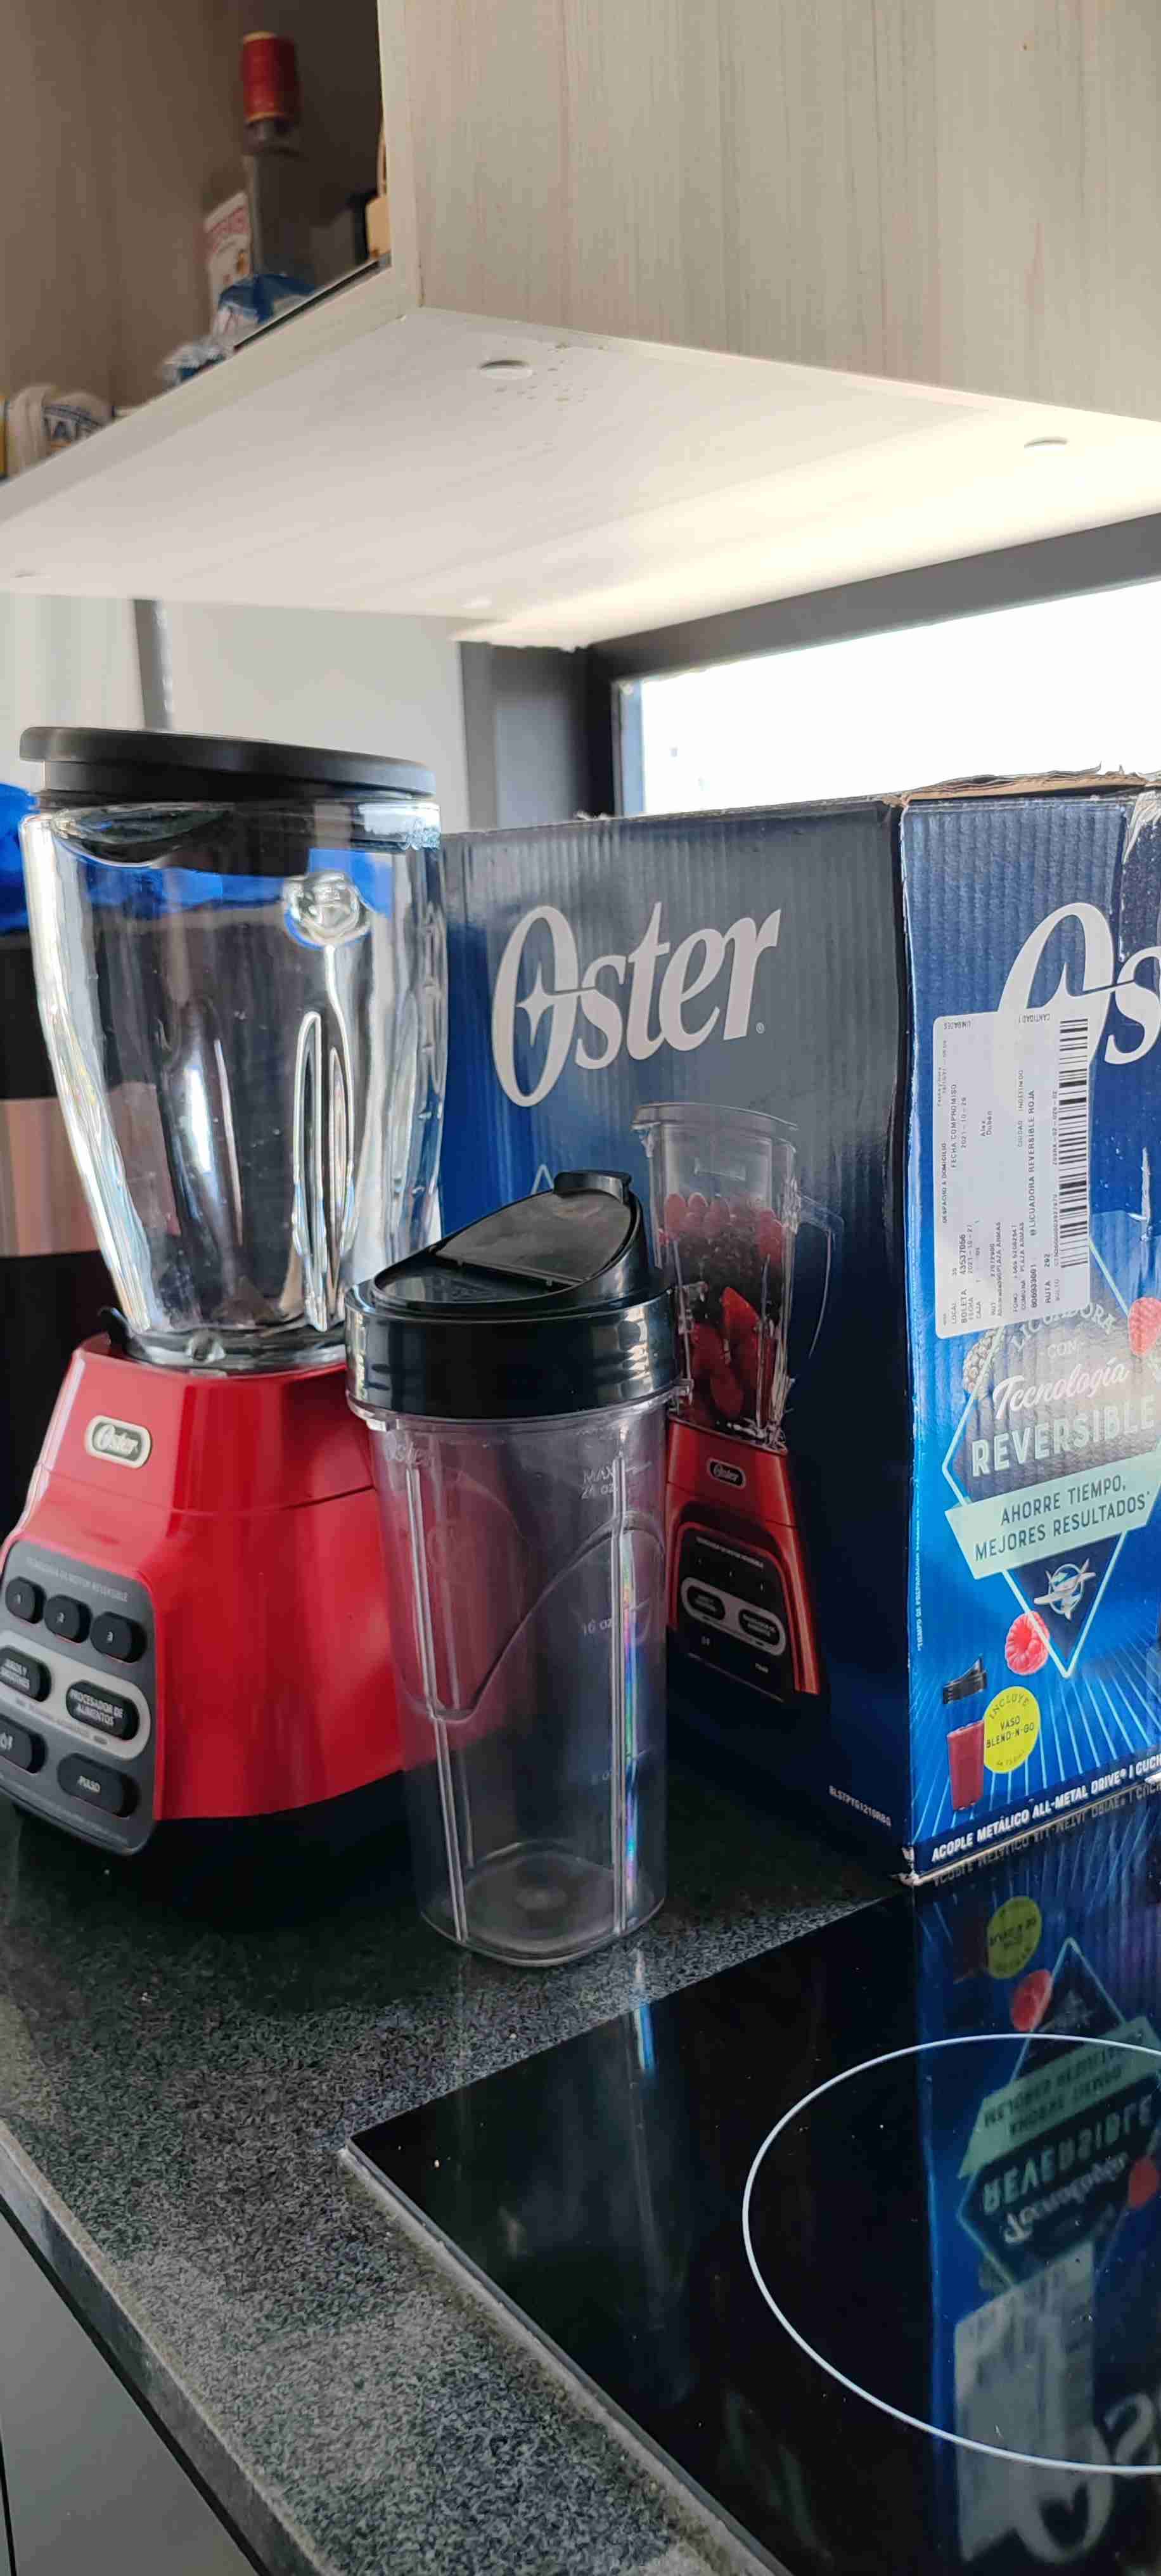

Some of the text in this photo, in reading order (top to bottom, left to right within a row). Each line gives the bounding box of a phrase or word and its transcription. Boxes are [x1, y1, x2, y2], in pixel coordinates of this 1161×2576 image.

[491, 902, 781, 1107] Oster
[1048, 1339, 1077, 1358] CON
[992, 1357, 1131, 1420] Tecnología
[972, 1393, 1156, 1478] REVERSIBLE
[1000, 1474, 1127, 1526] AHORRE TIEMPO,
[973, 1523, 1046, 1562] MEJORES
[56, 1611, 65, 1625] 2
[106, 1629, 115, 1643] 3
[113, 1706, 123, 1719] DE
[989, 1693, 1030, 1720] INCLUYE
[985, 1722, 1035, 1749] BLEND-N-GO
[1000, 1715, 1020, 1730] VASO
[77, 1775, 101, 1793] PULSO
[931, 1832, 974, 1862] ACOPLE
[976, 1809, 1030, 1843] METÁLICO
[1032, 1785, 1089, 1819] ALL-METAL
